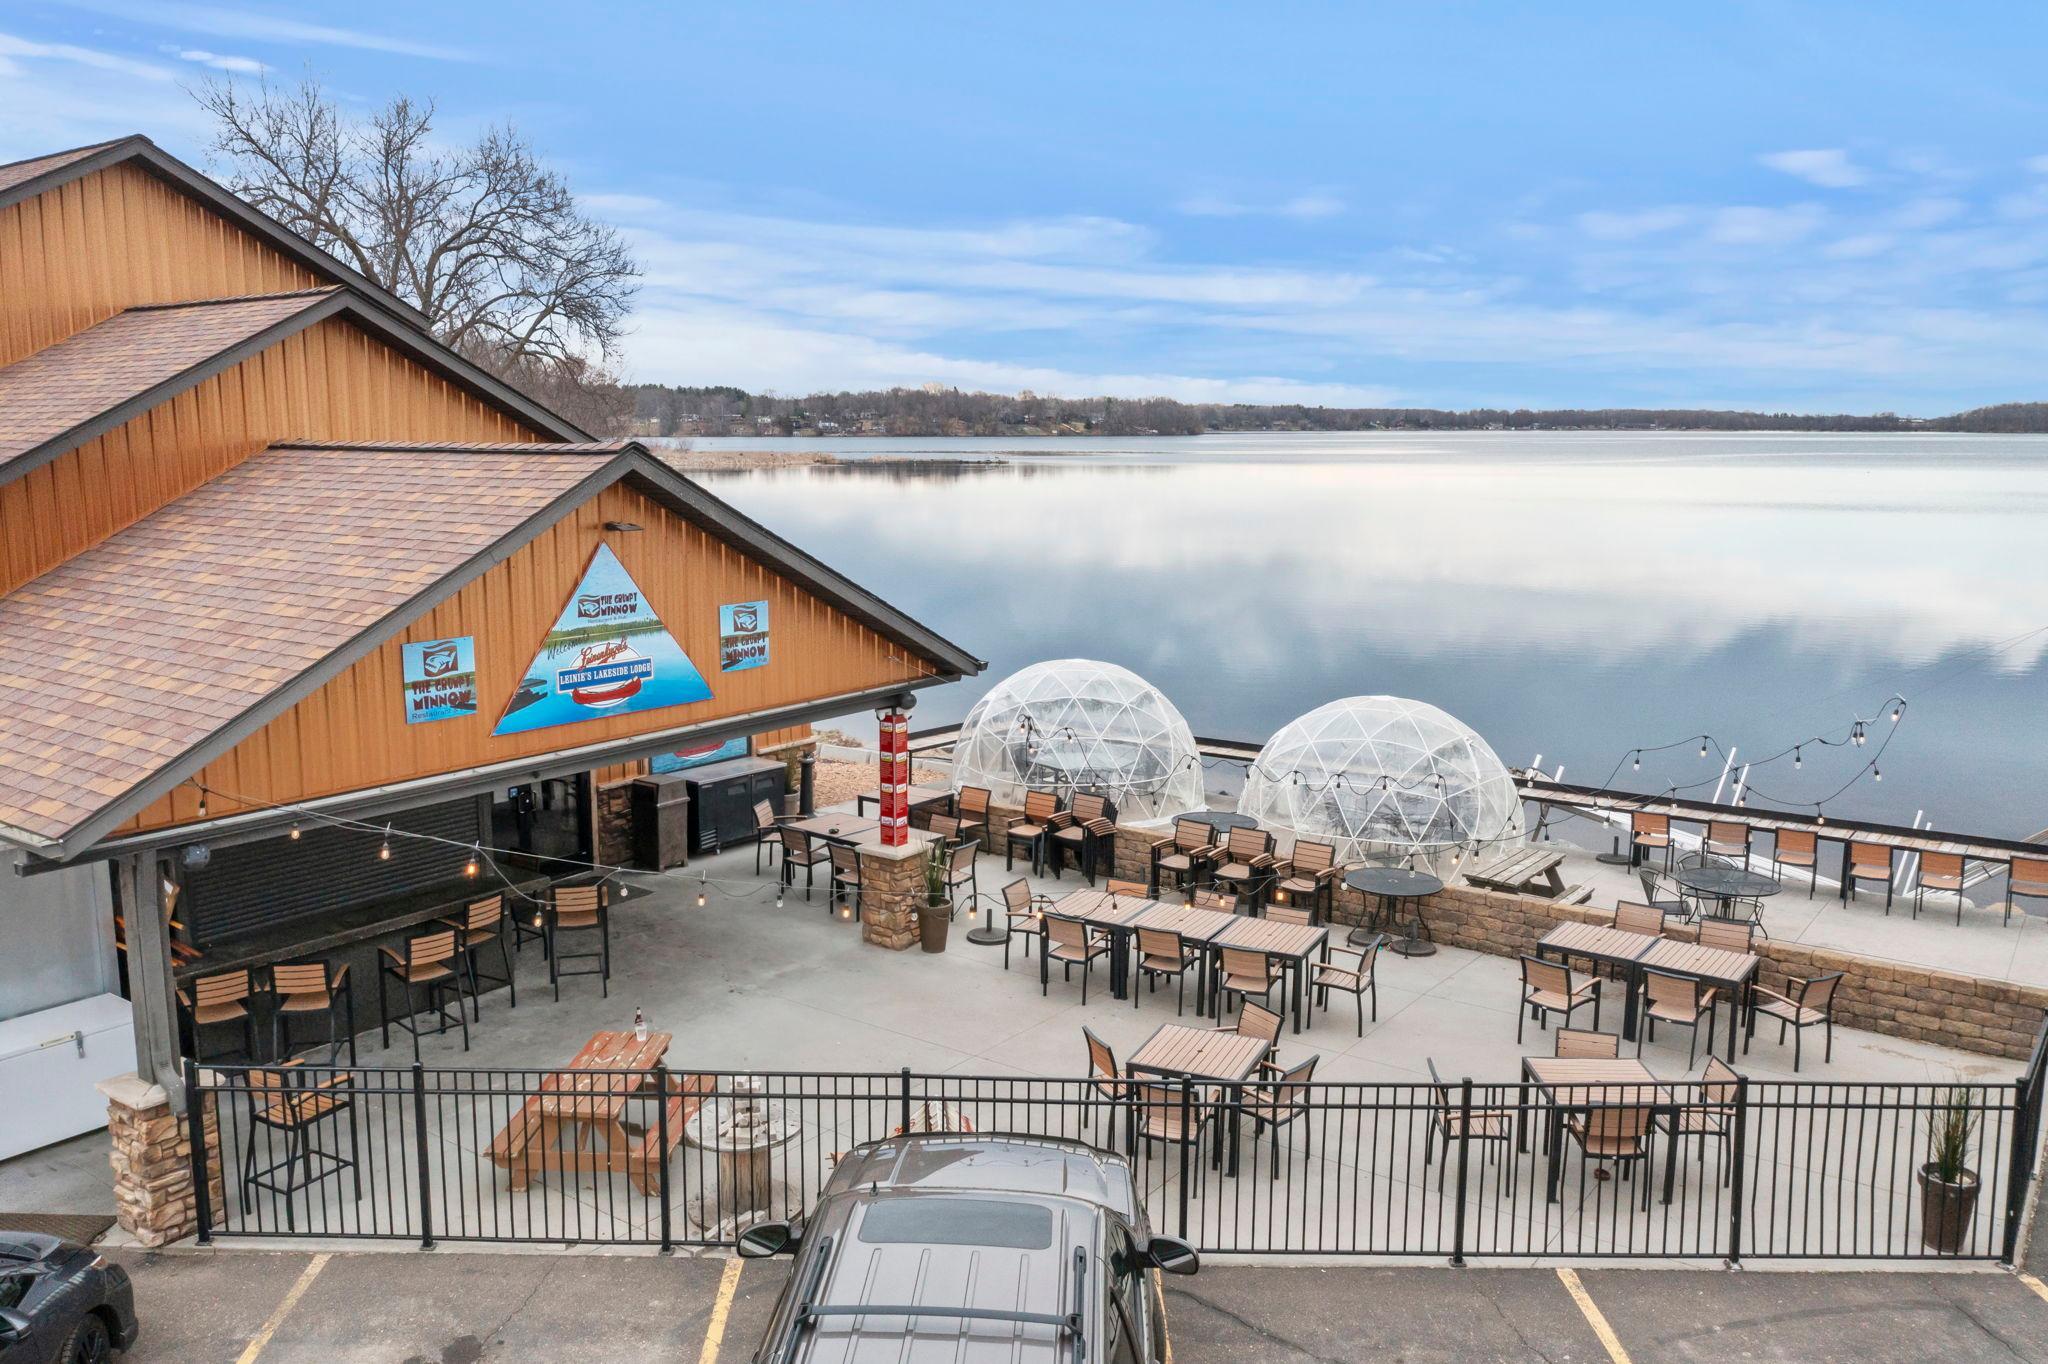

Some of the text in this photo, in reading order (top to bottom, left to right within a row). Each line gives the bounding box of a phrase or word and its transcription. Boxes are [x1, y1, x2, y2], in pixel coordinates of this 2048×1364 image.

[601, 592, 637, 605] THE GRUMPY
[601, 604, 637, 616] MINNOW
[725, 631, 765, 648] THE GRUMPY
[726, 645, 765, 661] MINNOW
[560, 662, 652, 685] LEINIE'S LAKESIDE LODGE
[412, 674, 470, 695] THE GRUMPY
[413, 690, 471, 711] MINNOW
